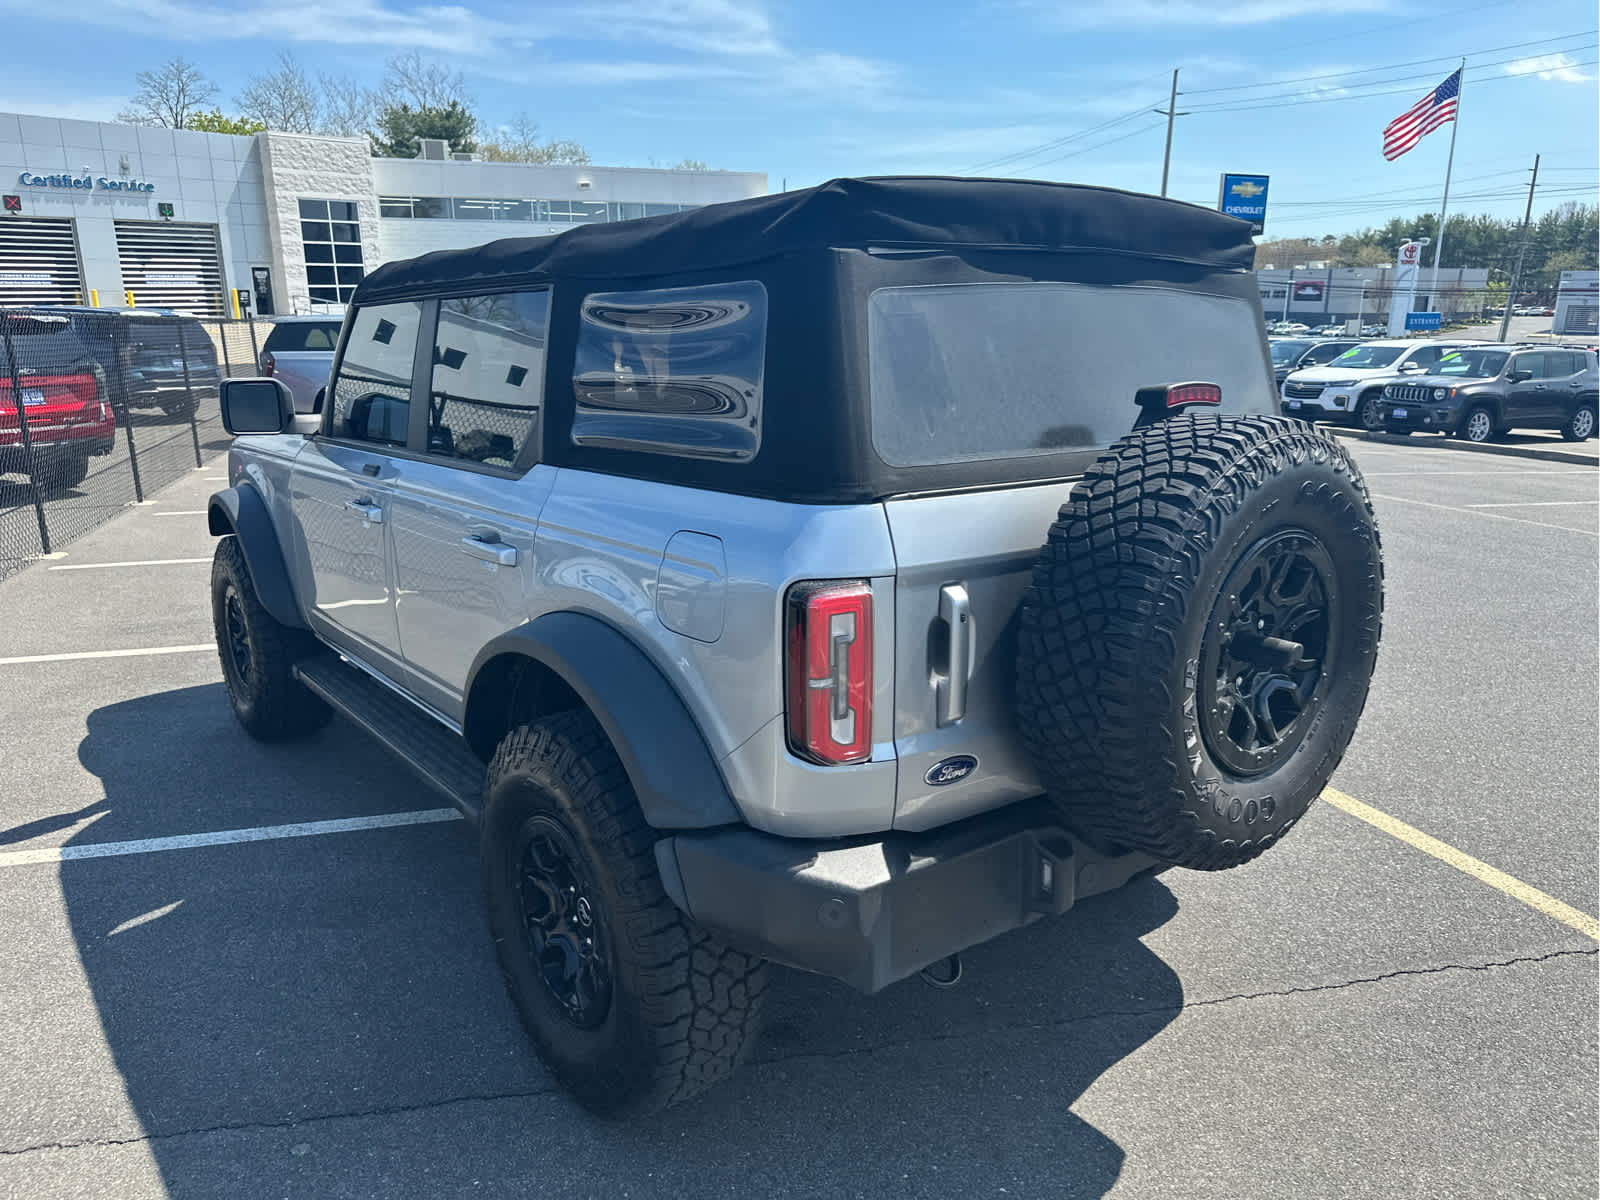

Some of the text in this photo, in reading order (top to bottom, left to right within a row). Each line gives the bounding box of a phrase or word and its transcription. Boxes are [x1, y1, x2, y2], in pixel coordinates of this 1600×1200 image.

[20, 172, 155, 193] Certified Service
[1225, 206, 1265, 214] CHEVROLET
[938, 764, 970, 781] Ford
